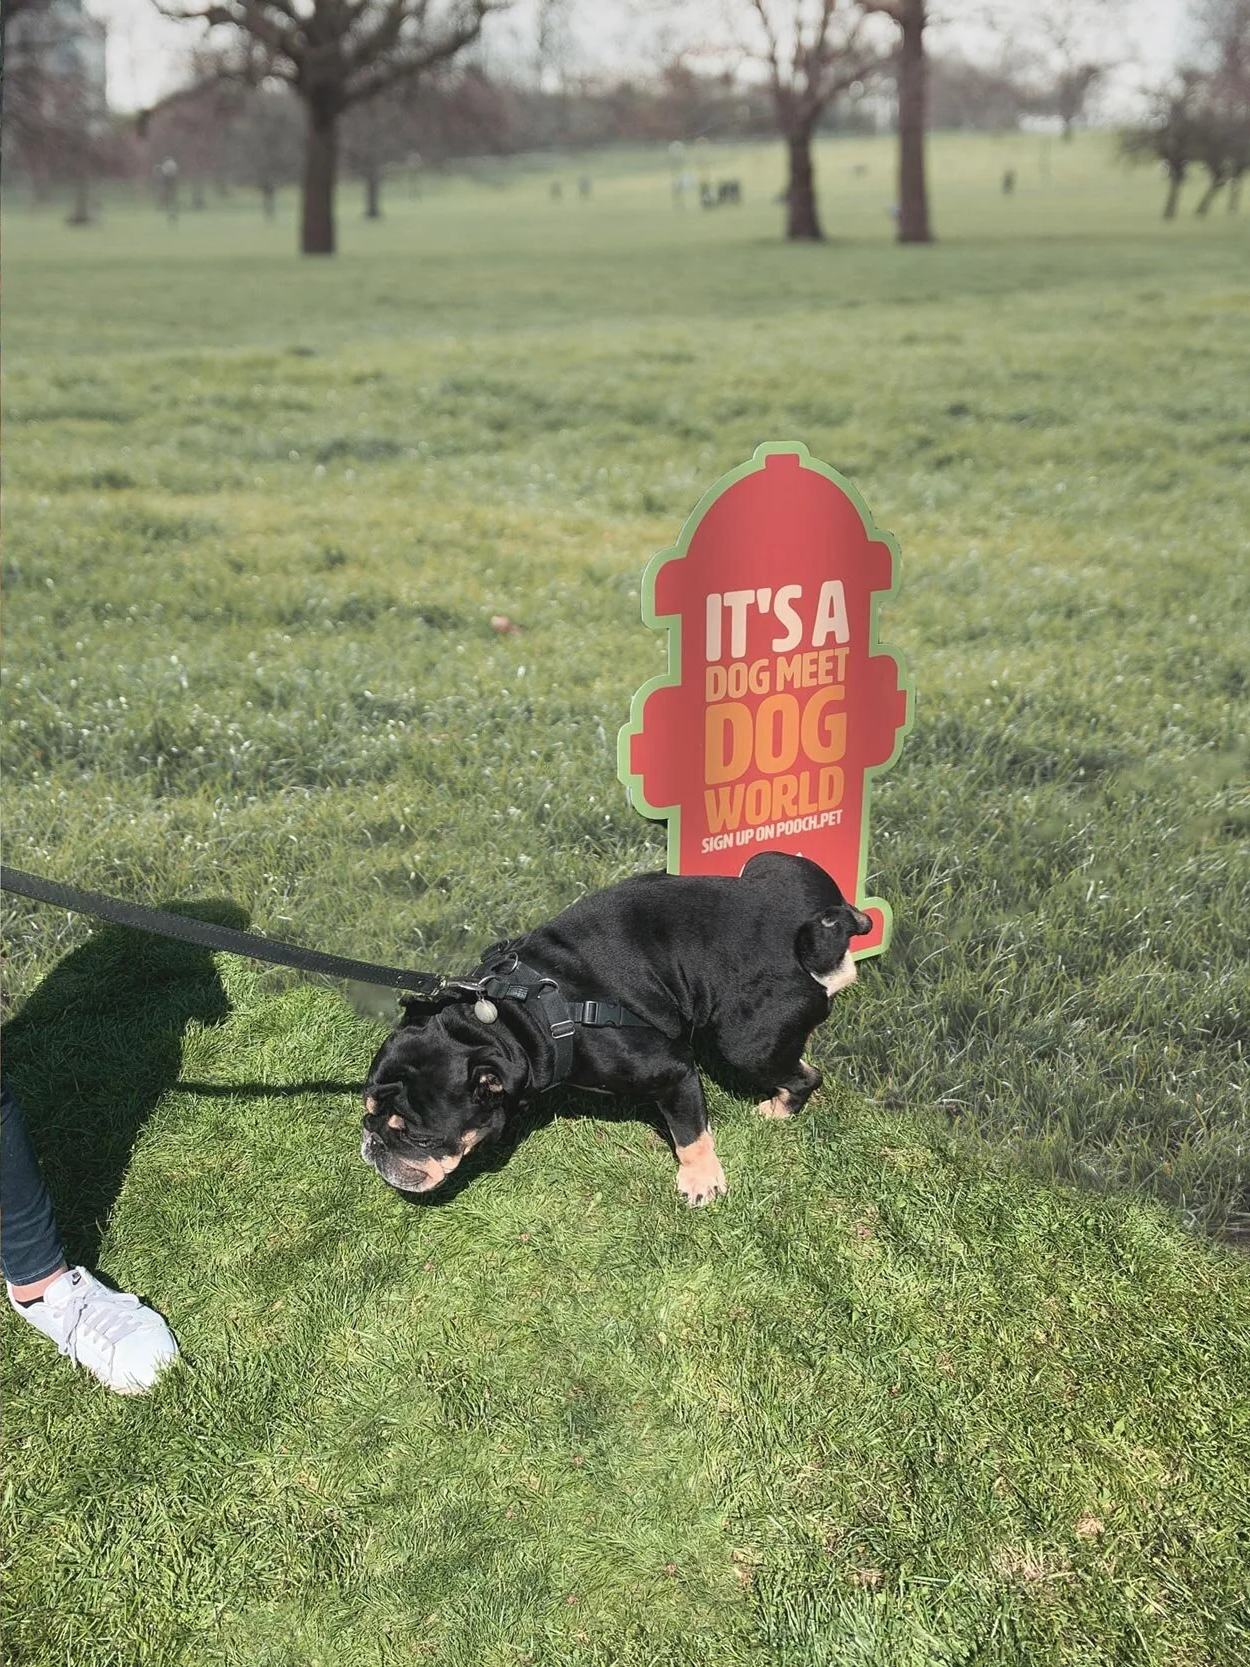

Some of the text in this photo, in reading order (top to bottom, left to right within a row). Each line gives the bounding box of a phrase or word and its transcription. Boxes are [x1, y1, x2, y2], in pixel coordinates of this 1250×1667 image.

[706, 580, 850, 662] IT'S A
[705, 647, 850, 702] DOG MEET
[704, 685, 846, 786] DOG
[702, 810, 843, 854] SIGN UP ON POOCH.PET
[704, 766, 844, 834] WORLD
